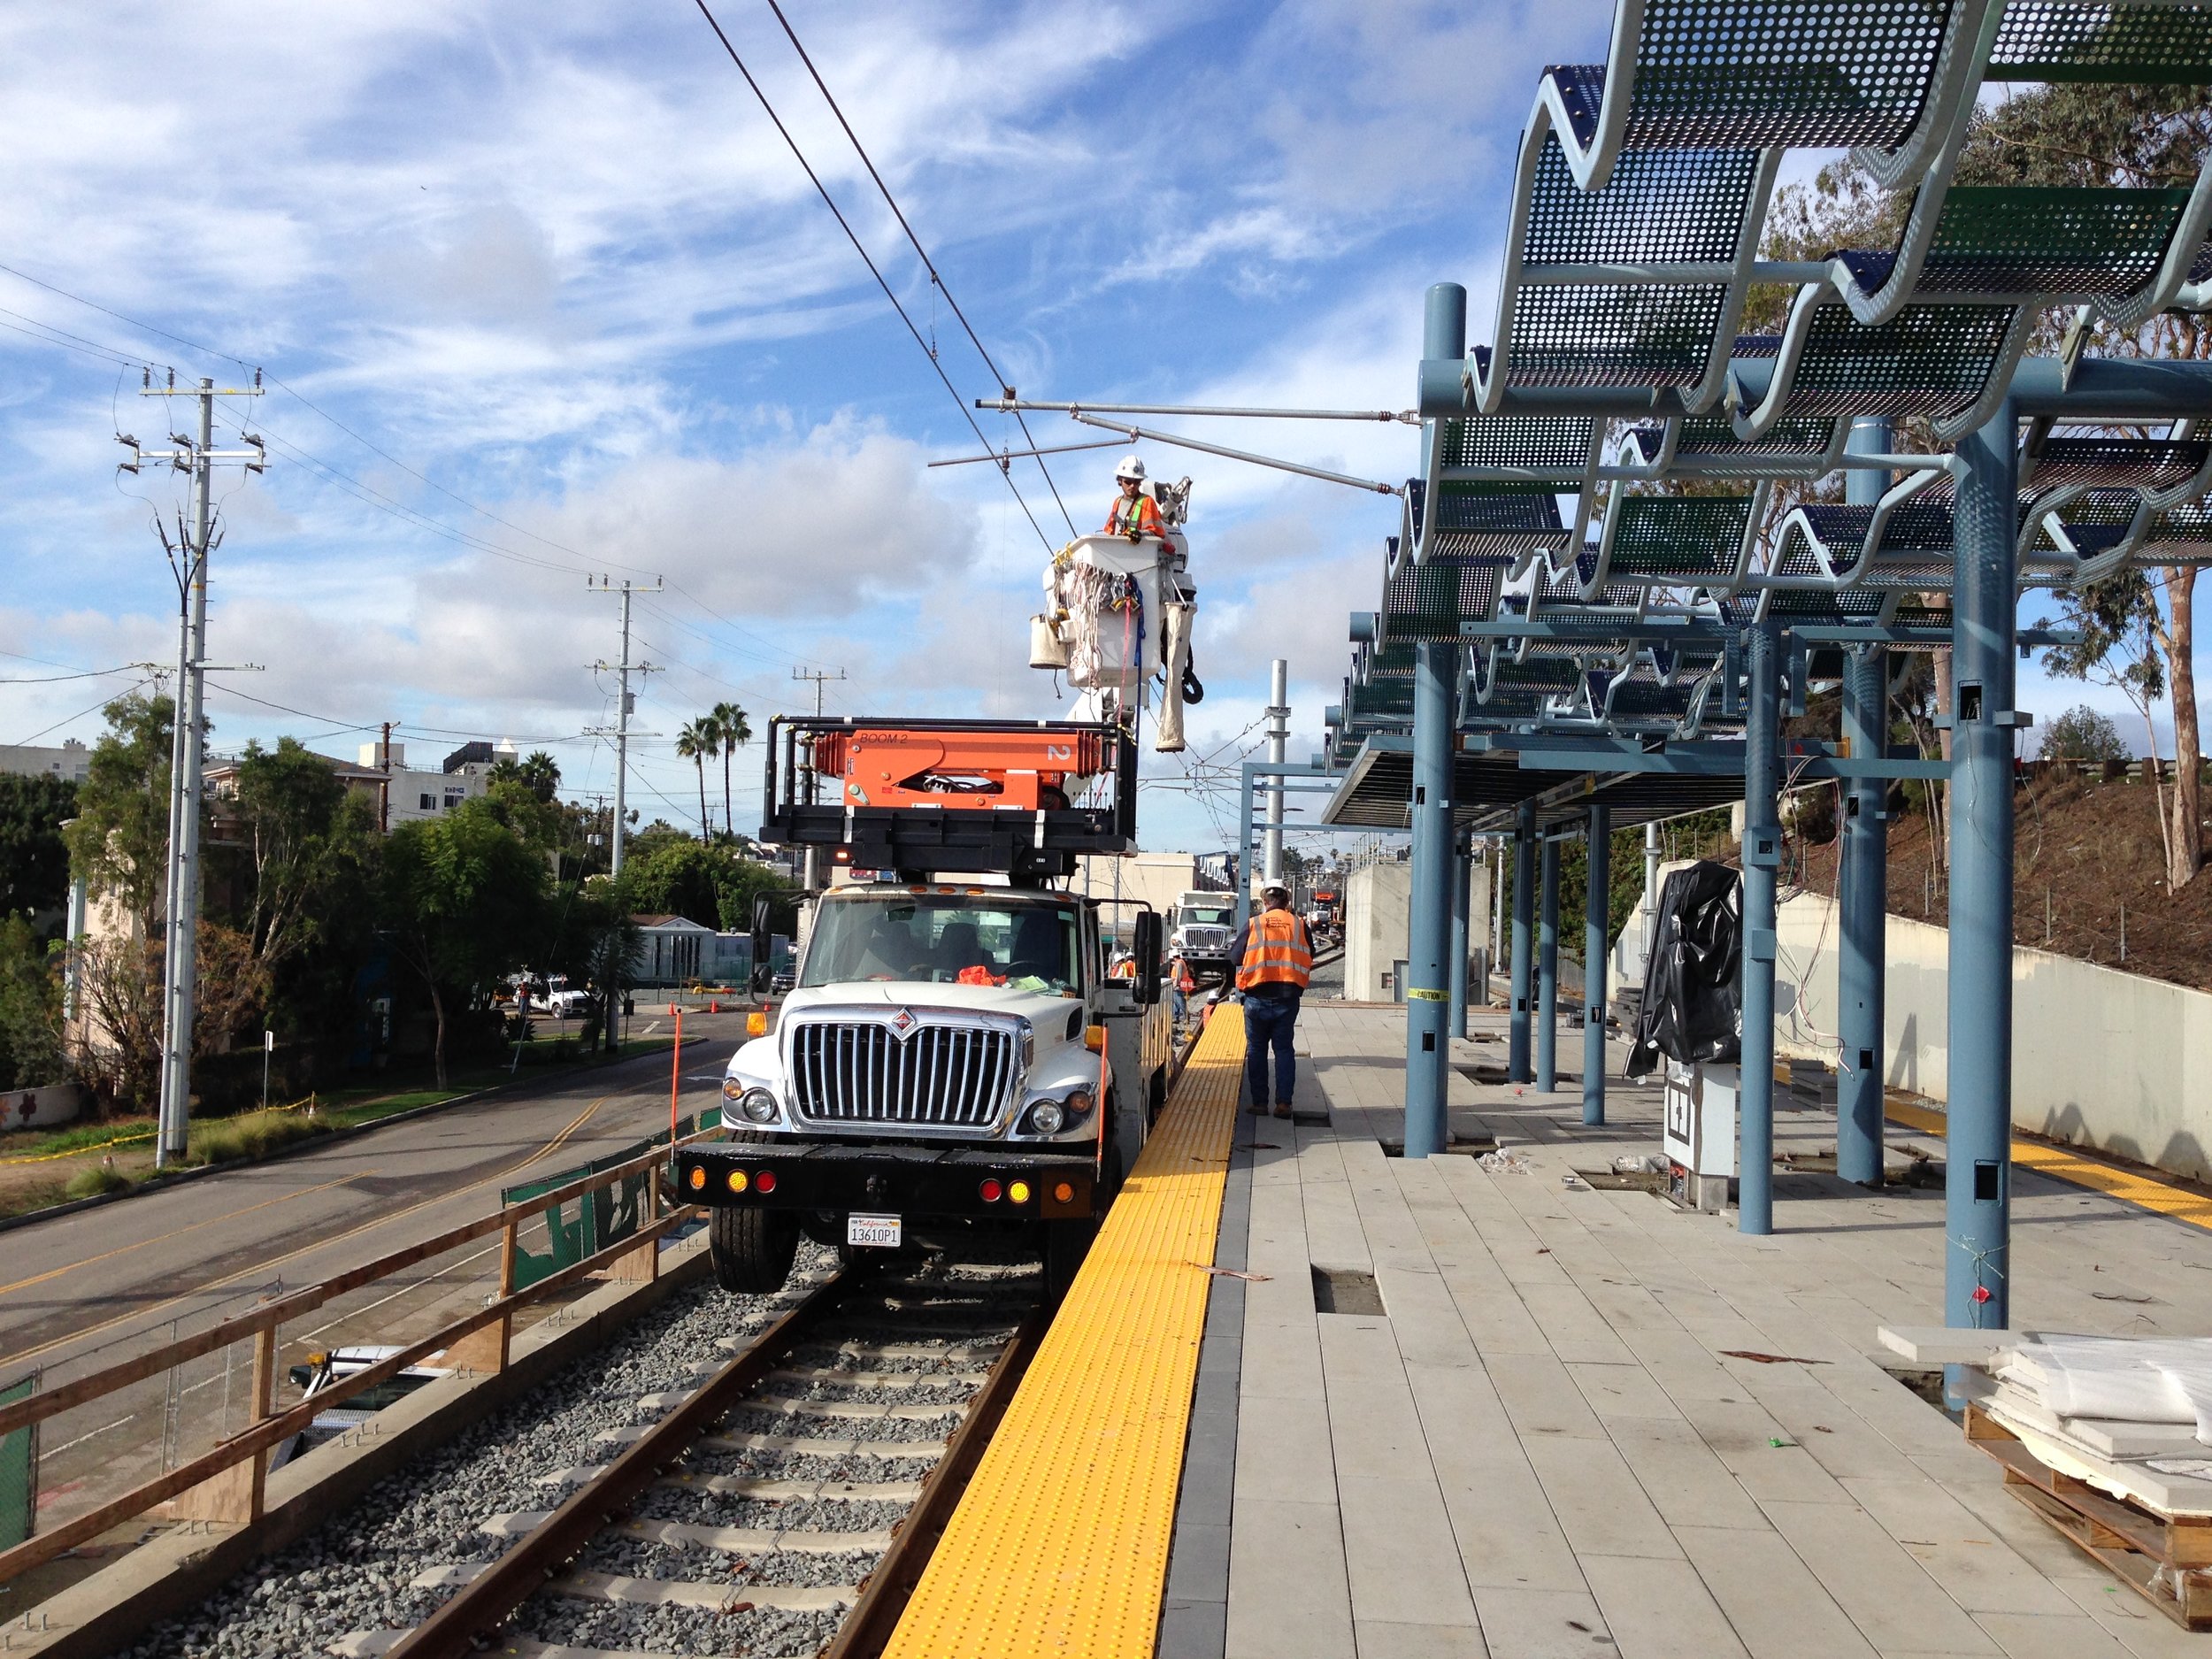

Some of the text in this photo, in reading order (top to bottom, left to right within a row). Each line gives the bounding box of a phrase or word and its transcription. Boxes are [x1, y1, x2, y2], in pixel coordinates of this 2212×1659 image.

[860, 733, 908, 744] BOOM 2
[1048, 745, 1071, 761] 2
[1417, 991, 1440, 1000] CAUTION
[851, 1228, 897, 1242] 13610P1
